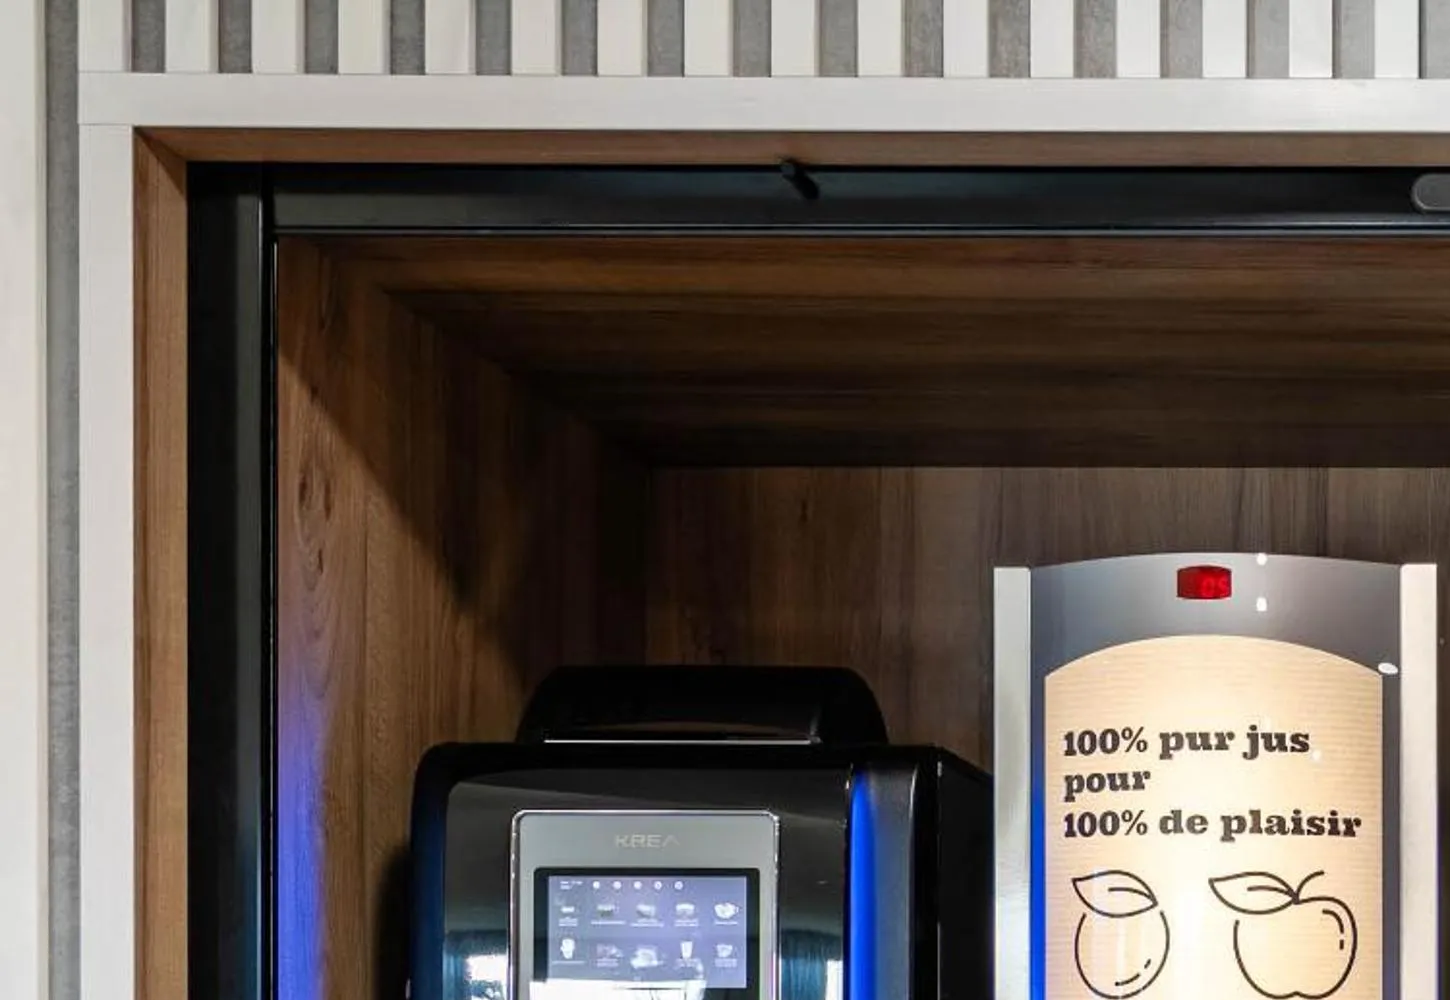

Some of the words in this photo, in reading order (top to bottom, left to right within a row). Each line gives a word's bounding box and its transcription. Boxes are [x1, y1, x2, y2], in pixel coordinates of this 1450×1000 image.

[1064, 726, 1148, 757] 100%
[1159, 730, 1236, 761] pur
[1242, 724, 1311, 761] jus
[1064, 770, 1151, 803] pour
[1064, 810, 1148, 838] 100%
[1159, 809, 1209, 835] de
[1220, 809, 1362, 843] plaisir
